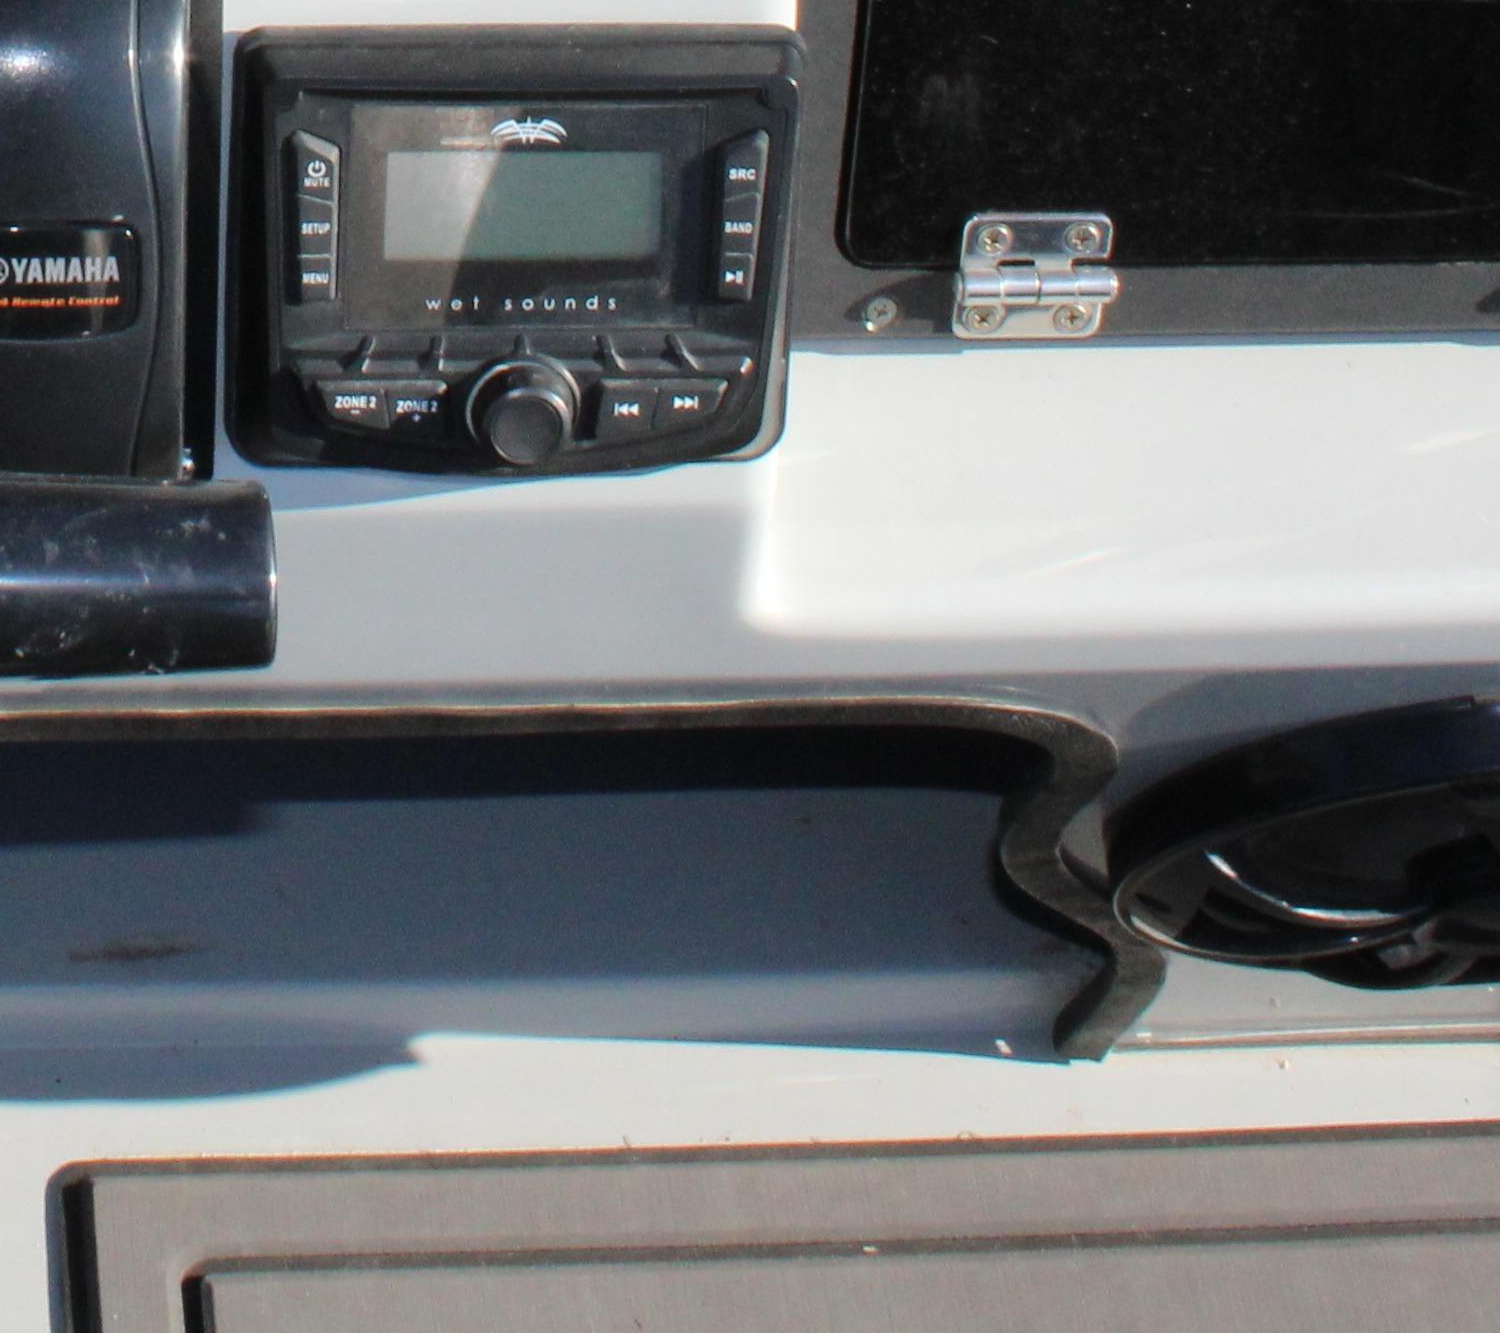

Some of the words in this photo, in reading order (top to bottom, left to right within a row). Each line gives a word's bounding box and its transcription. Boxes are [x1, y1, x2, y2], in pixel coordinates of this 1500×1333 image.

[729, 168, 756, 181] SRC
[304, 177, 330, 187] MUTE
[301, 222, 331, 235] SETUP
[724, 221, 753, 234] BAND
[11, 256, 120, 283] YAMAHA
[302, 272, 330, 285] MENU
[425, 295, 480, 311] wet
[505, 295, 617, 311] sounds
[335, 395, 365, 409] ZONE
[396, 399, 426, 413] ZONE
